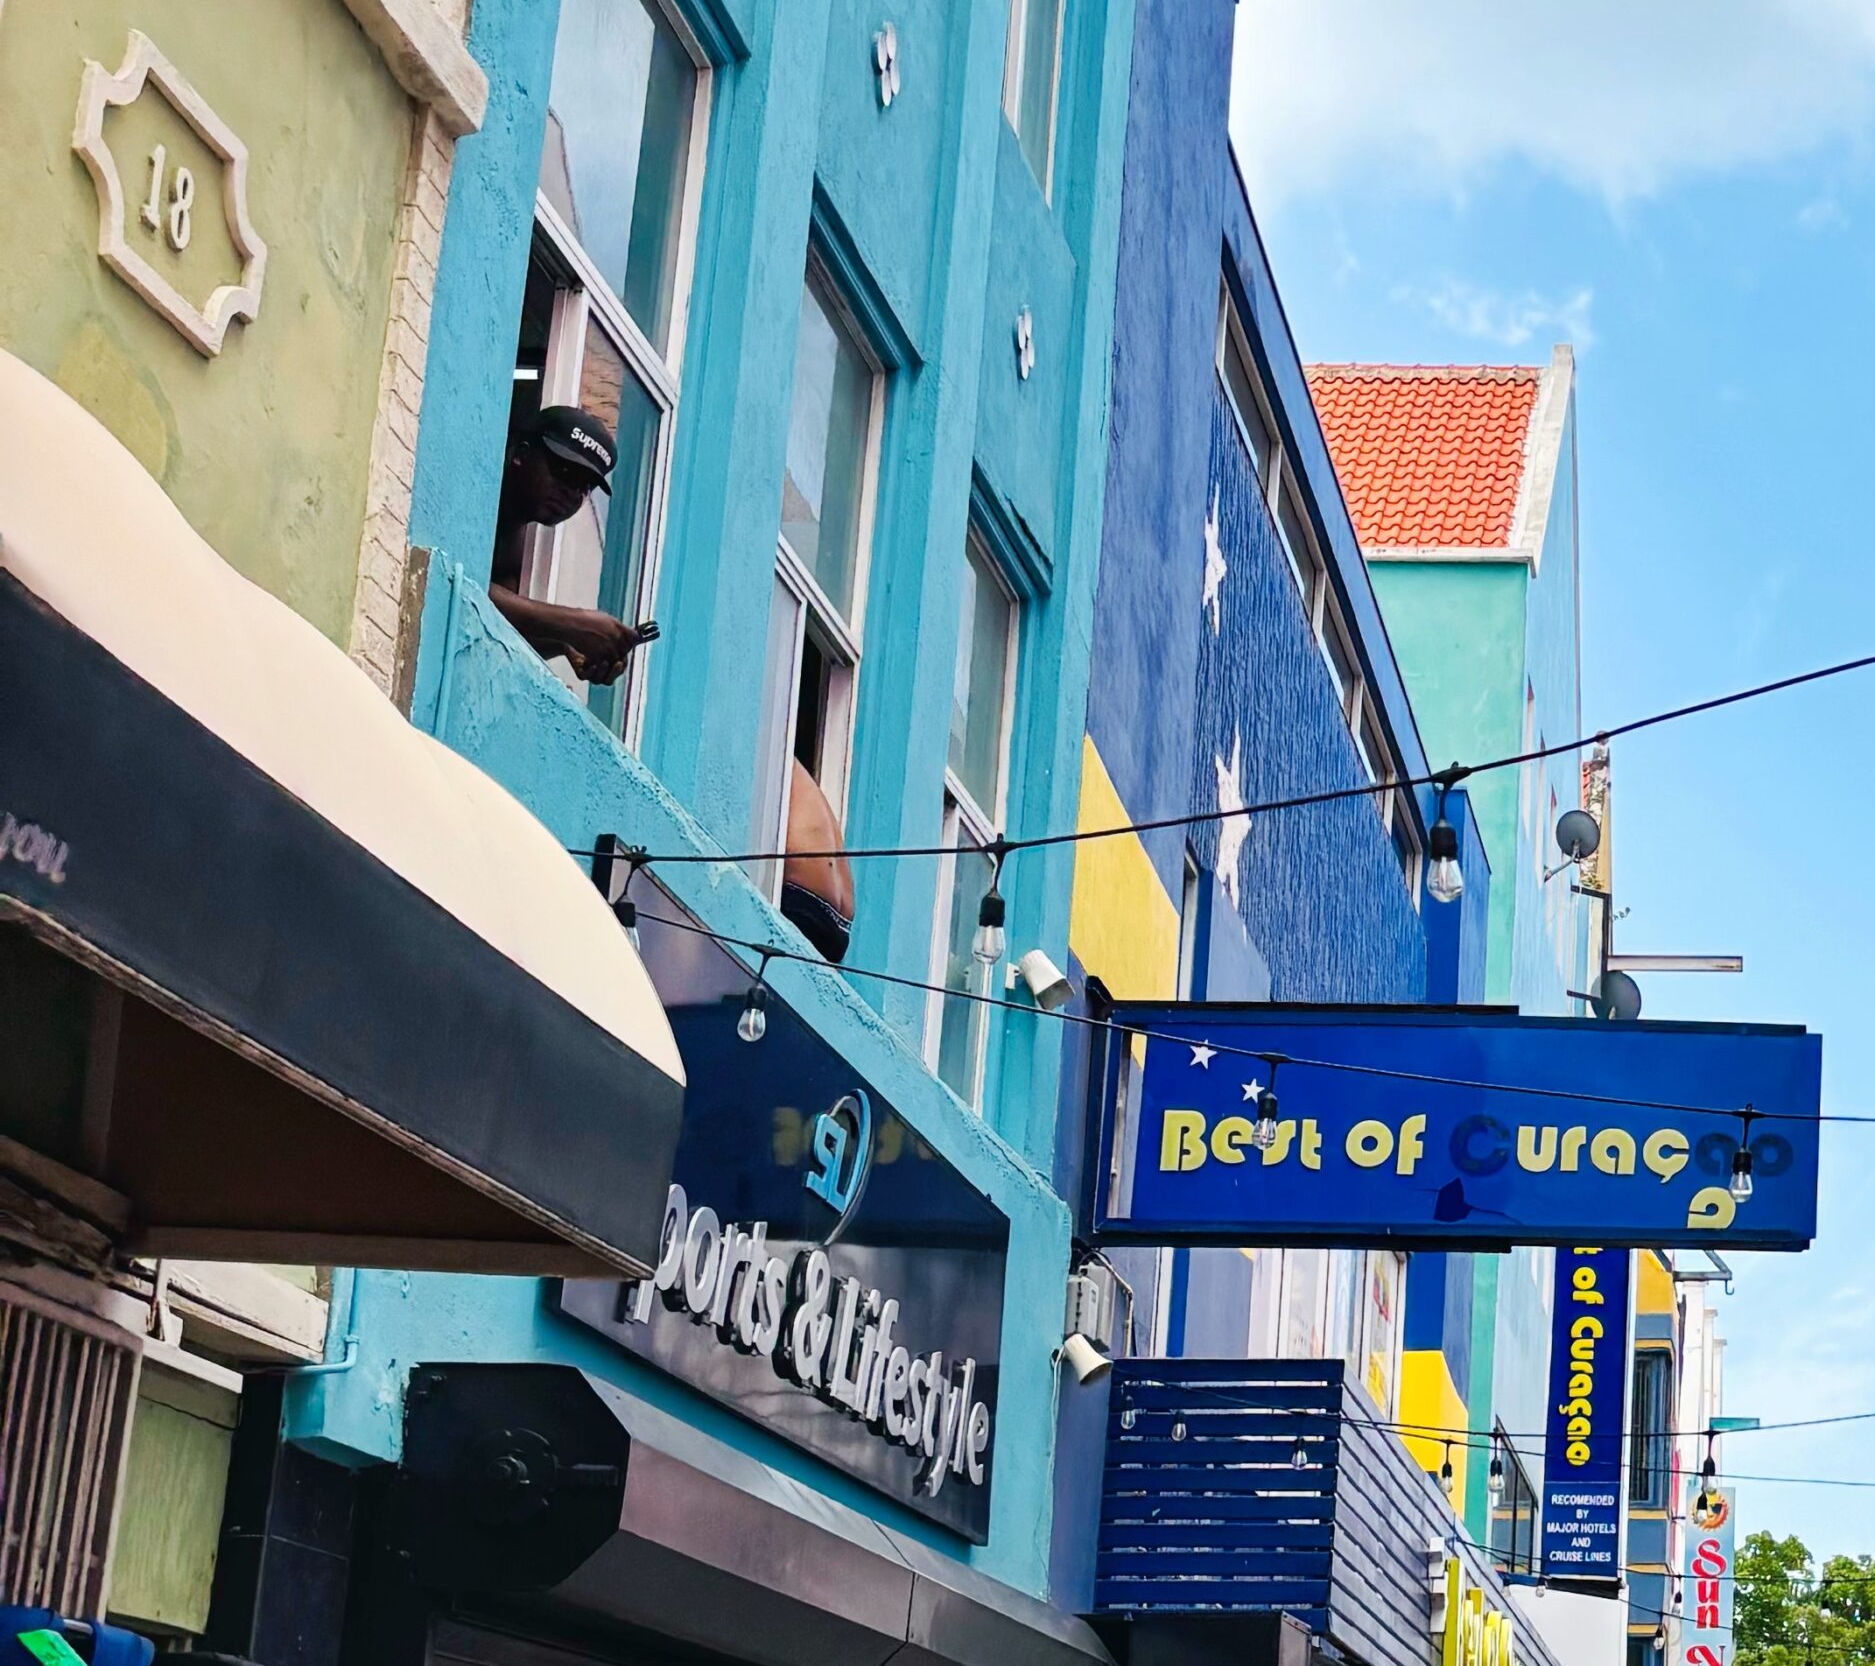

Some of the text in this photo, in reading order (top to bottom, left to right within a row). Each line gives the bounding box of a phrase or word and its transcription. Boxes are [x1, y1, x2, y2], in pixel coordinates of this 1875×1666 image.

[139, 144, 195, 251] 18
[1159, 1110, 1322, 1171] Best
[1345, 1114, 1427, 1175] of
[1572, 1266, 1604, 1304] of
[634, 1184, 990, 1498] ports & Lifestyle
[1559, 1316, 1604, 1466] Curaçao
[1551, 1494, 1615, 1506] RECOMENDED
[1576, 1508, 1589, 1519] BY
[1546, 1522, 1617, 1534] MAJOR HOTELS
[1571, 1536, 1591, 1548] AND
[1549, 1550, 1612, 1562] CRUISE LINES
[1691, 1539, 1727, 1629] Sun
